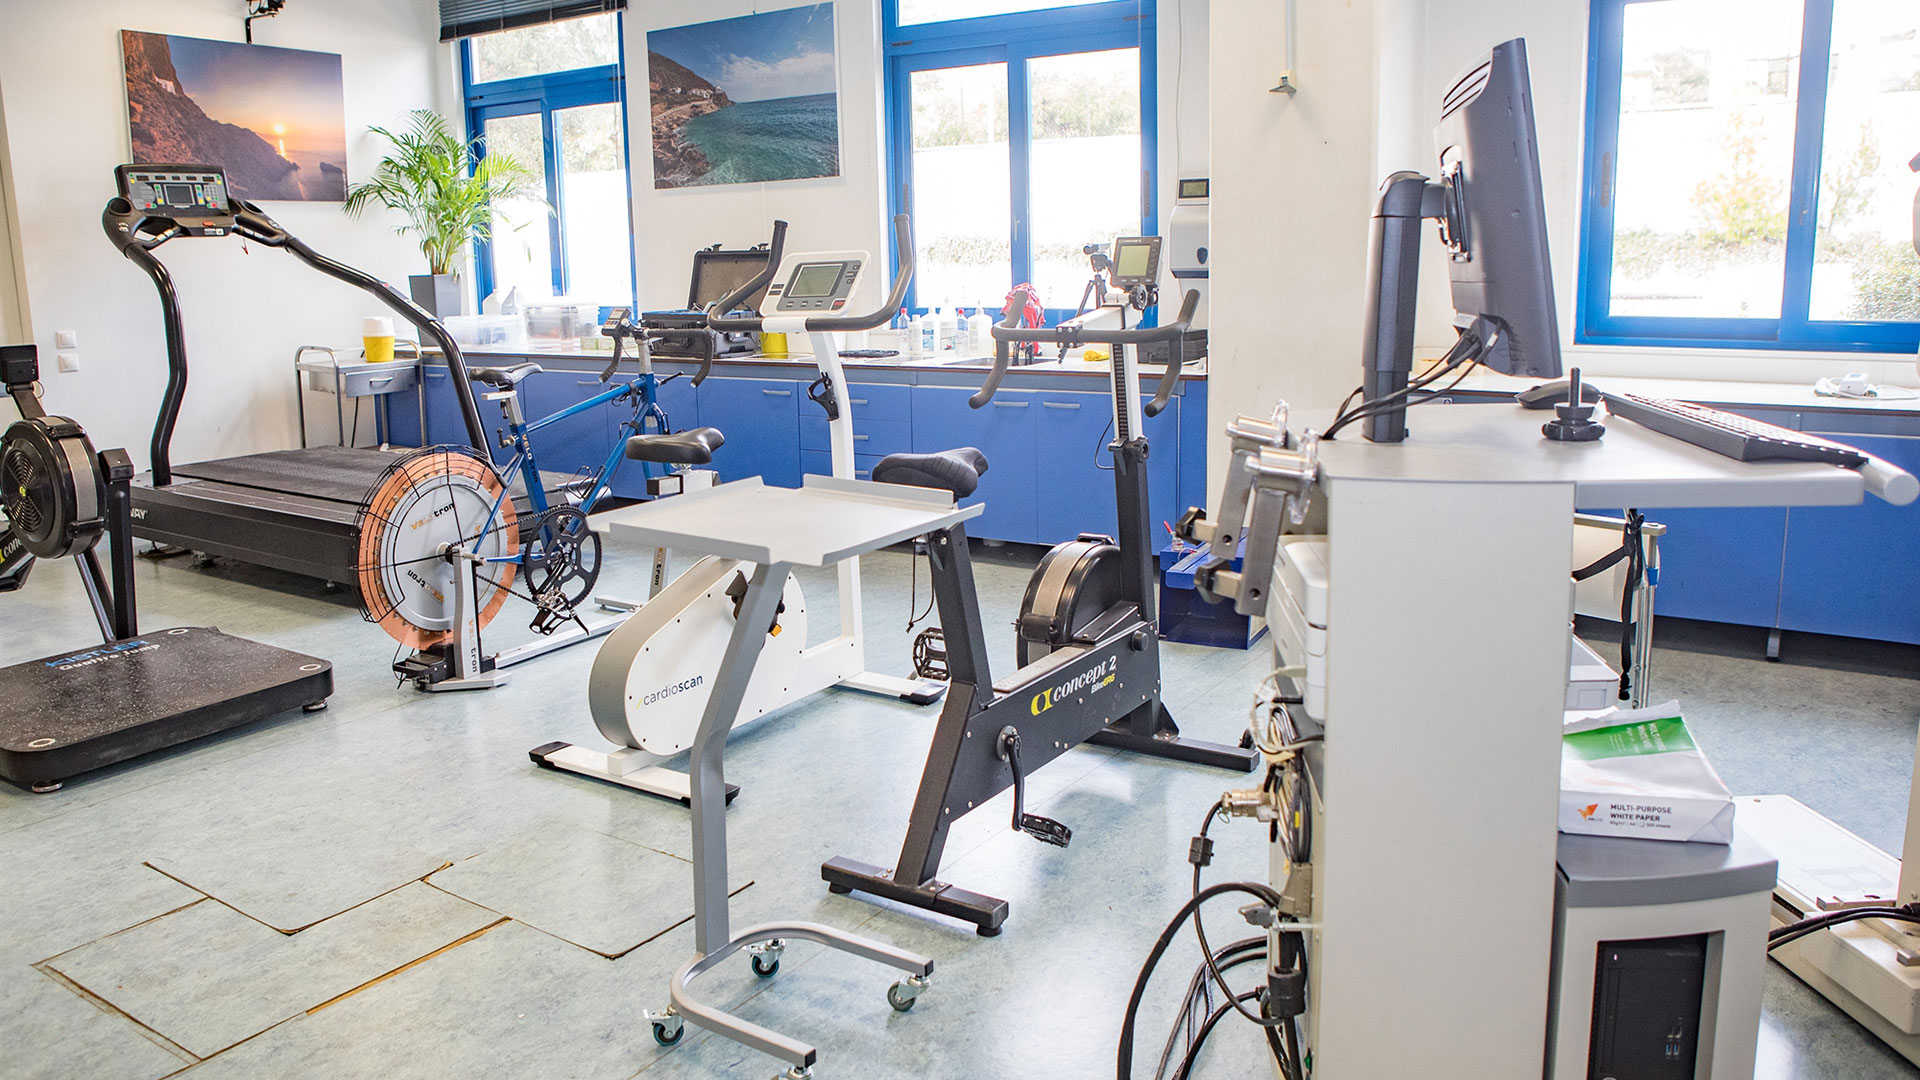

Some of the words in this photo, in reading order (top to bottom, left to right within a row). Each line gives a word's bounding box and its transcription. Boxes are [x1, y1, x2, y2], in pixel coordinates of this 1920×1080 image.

[45, 640, 149, 667] KISTLER
[123, 643, 161, 655] Jump
[643, 675, 703, 706] cardioscan
[1053, 661, 1107, 702] concept
[1109, 655, 1117, 671] 2
[1610, 804, 1672, 814] MULTI-PURPOSE
